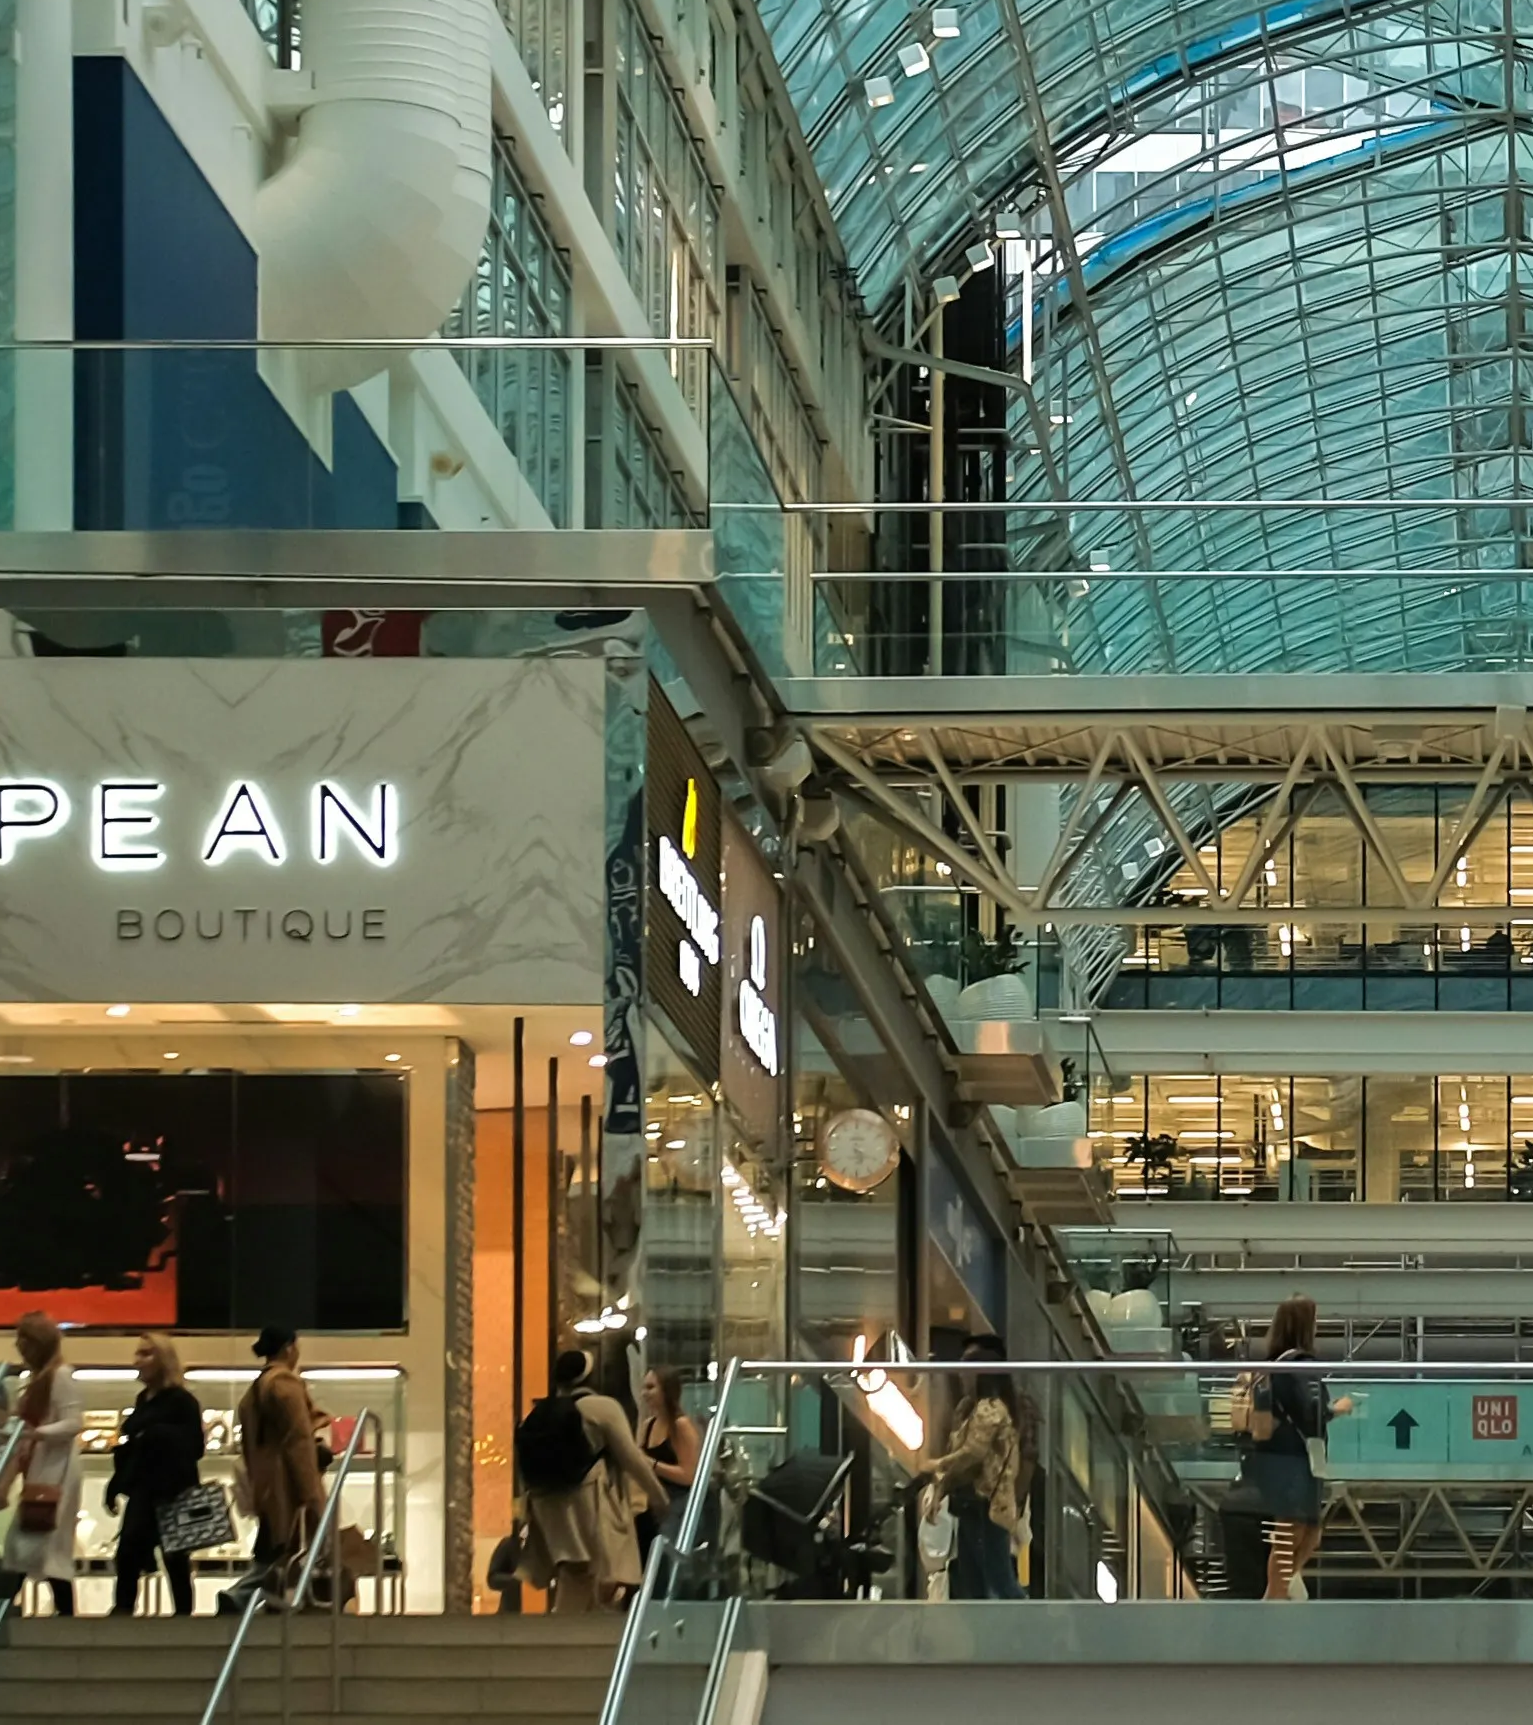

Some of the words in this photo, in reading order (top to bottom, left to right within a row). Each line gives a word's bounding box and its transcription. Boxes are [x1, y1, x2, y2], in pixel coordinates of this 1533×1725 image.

[117, 908, 388, 942] BOUTIQUE
[1477, 1401, 1510, 1416] UNI
[1477, 1419, 1513, 1437] QLO
